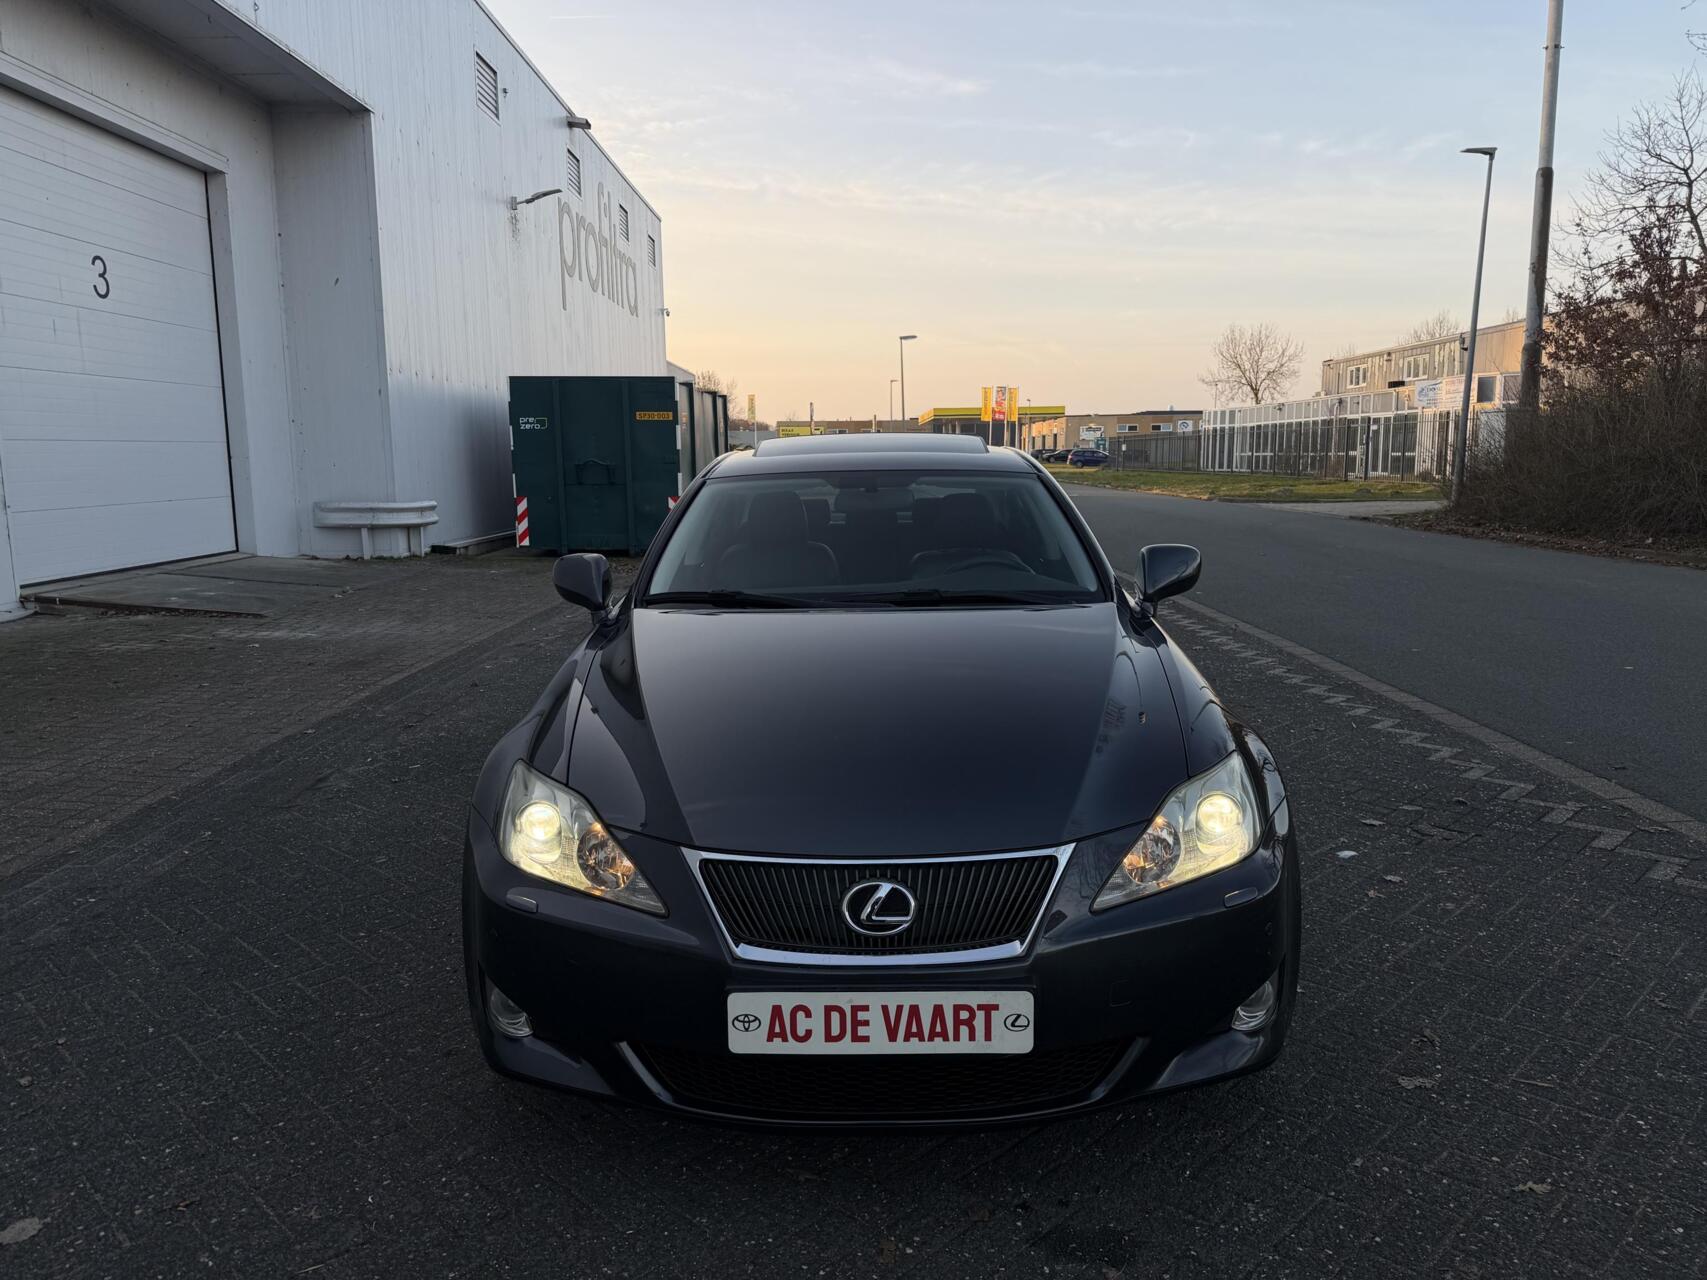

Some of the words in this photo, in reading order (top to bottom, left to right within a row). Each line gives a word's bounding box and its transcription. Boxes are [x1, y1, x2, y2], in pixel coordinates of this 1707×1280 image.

[557, 181, 639, 318] profiltra
[91, 254, 110, 299] 3
[519, 417, 535, 426] pre
[766, 1004, 813, 1043] AC
[823, 1004, 870, 1043] DE
[880, 1003, 1000, 1043] VAART
